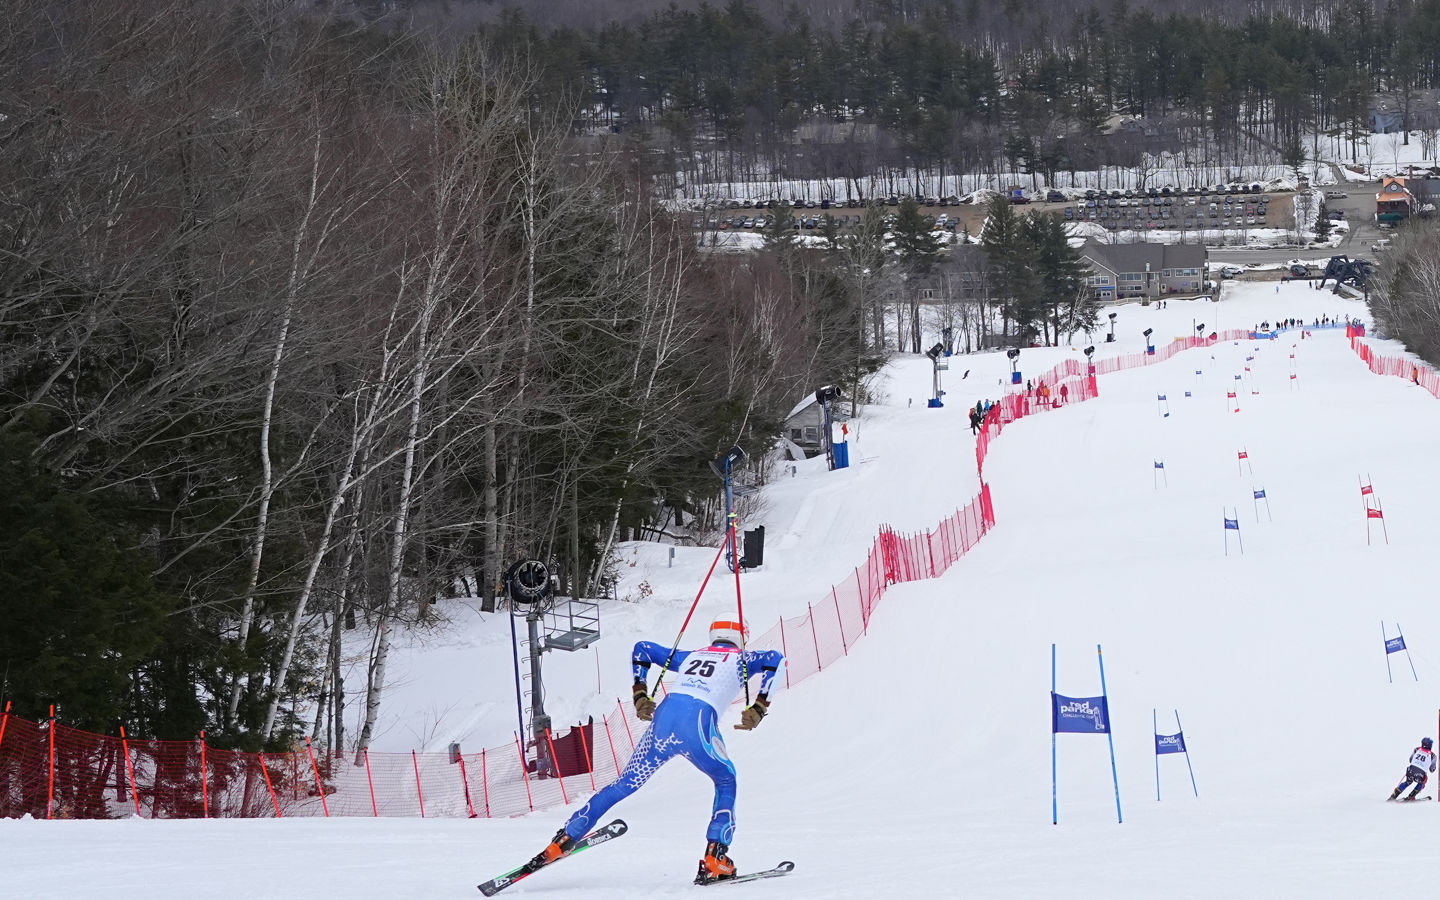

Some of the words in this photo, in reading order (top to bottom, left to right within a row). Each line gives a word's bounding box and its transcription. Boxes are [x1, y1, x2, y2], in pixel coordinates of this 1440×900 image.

[684, 660, 717, 678] 25
[1070, 701, 1089, 709] red
[1061, 705, 1094, 715] parka
[1415, 754, 1426, 762] 28
